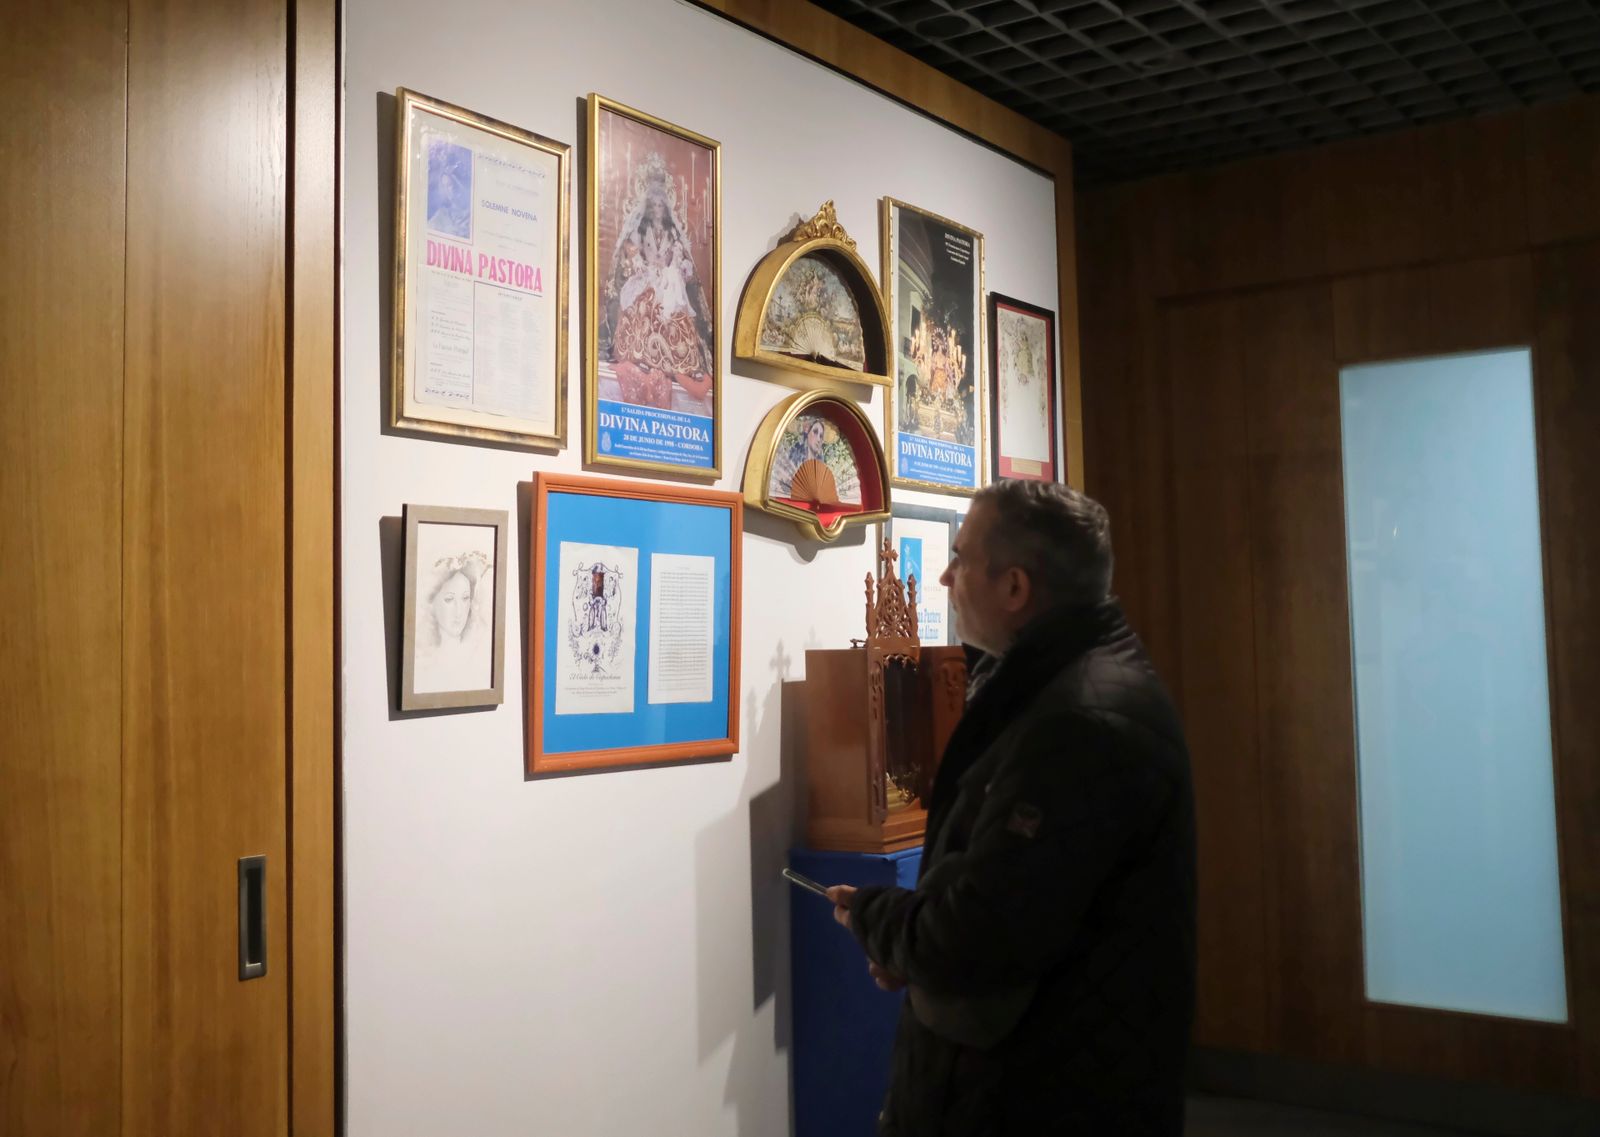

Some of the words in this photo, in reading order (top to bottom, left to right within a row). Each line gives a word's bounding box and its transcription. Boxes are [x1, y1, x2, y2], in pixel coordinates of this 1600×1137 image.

[481, 199, 509, 216] SOLEMNE
[511, 208, 537, 222] NOVENA
[426, 239, 473, 276] DIVINA
[478, 253, 543, 293] PASTORA
[600, 412, 649, 434] DIVINA
[652, 420, 709, 443] PASTORA
[638, 436, 655, 445] JUNIO
[901, 441, 933, 460] DIVINA
[934, 447, 972, 468] PASTORA
